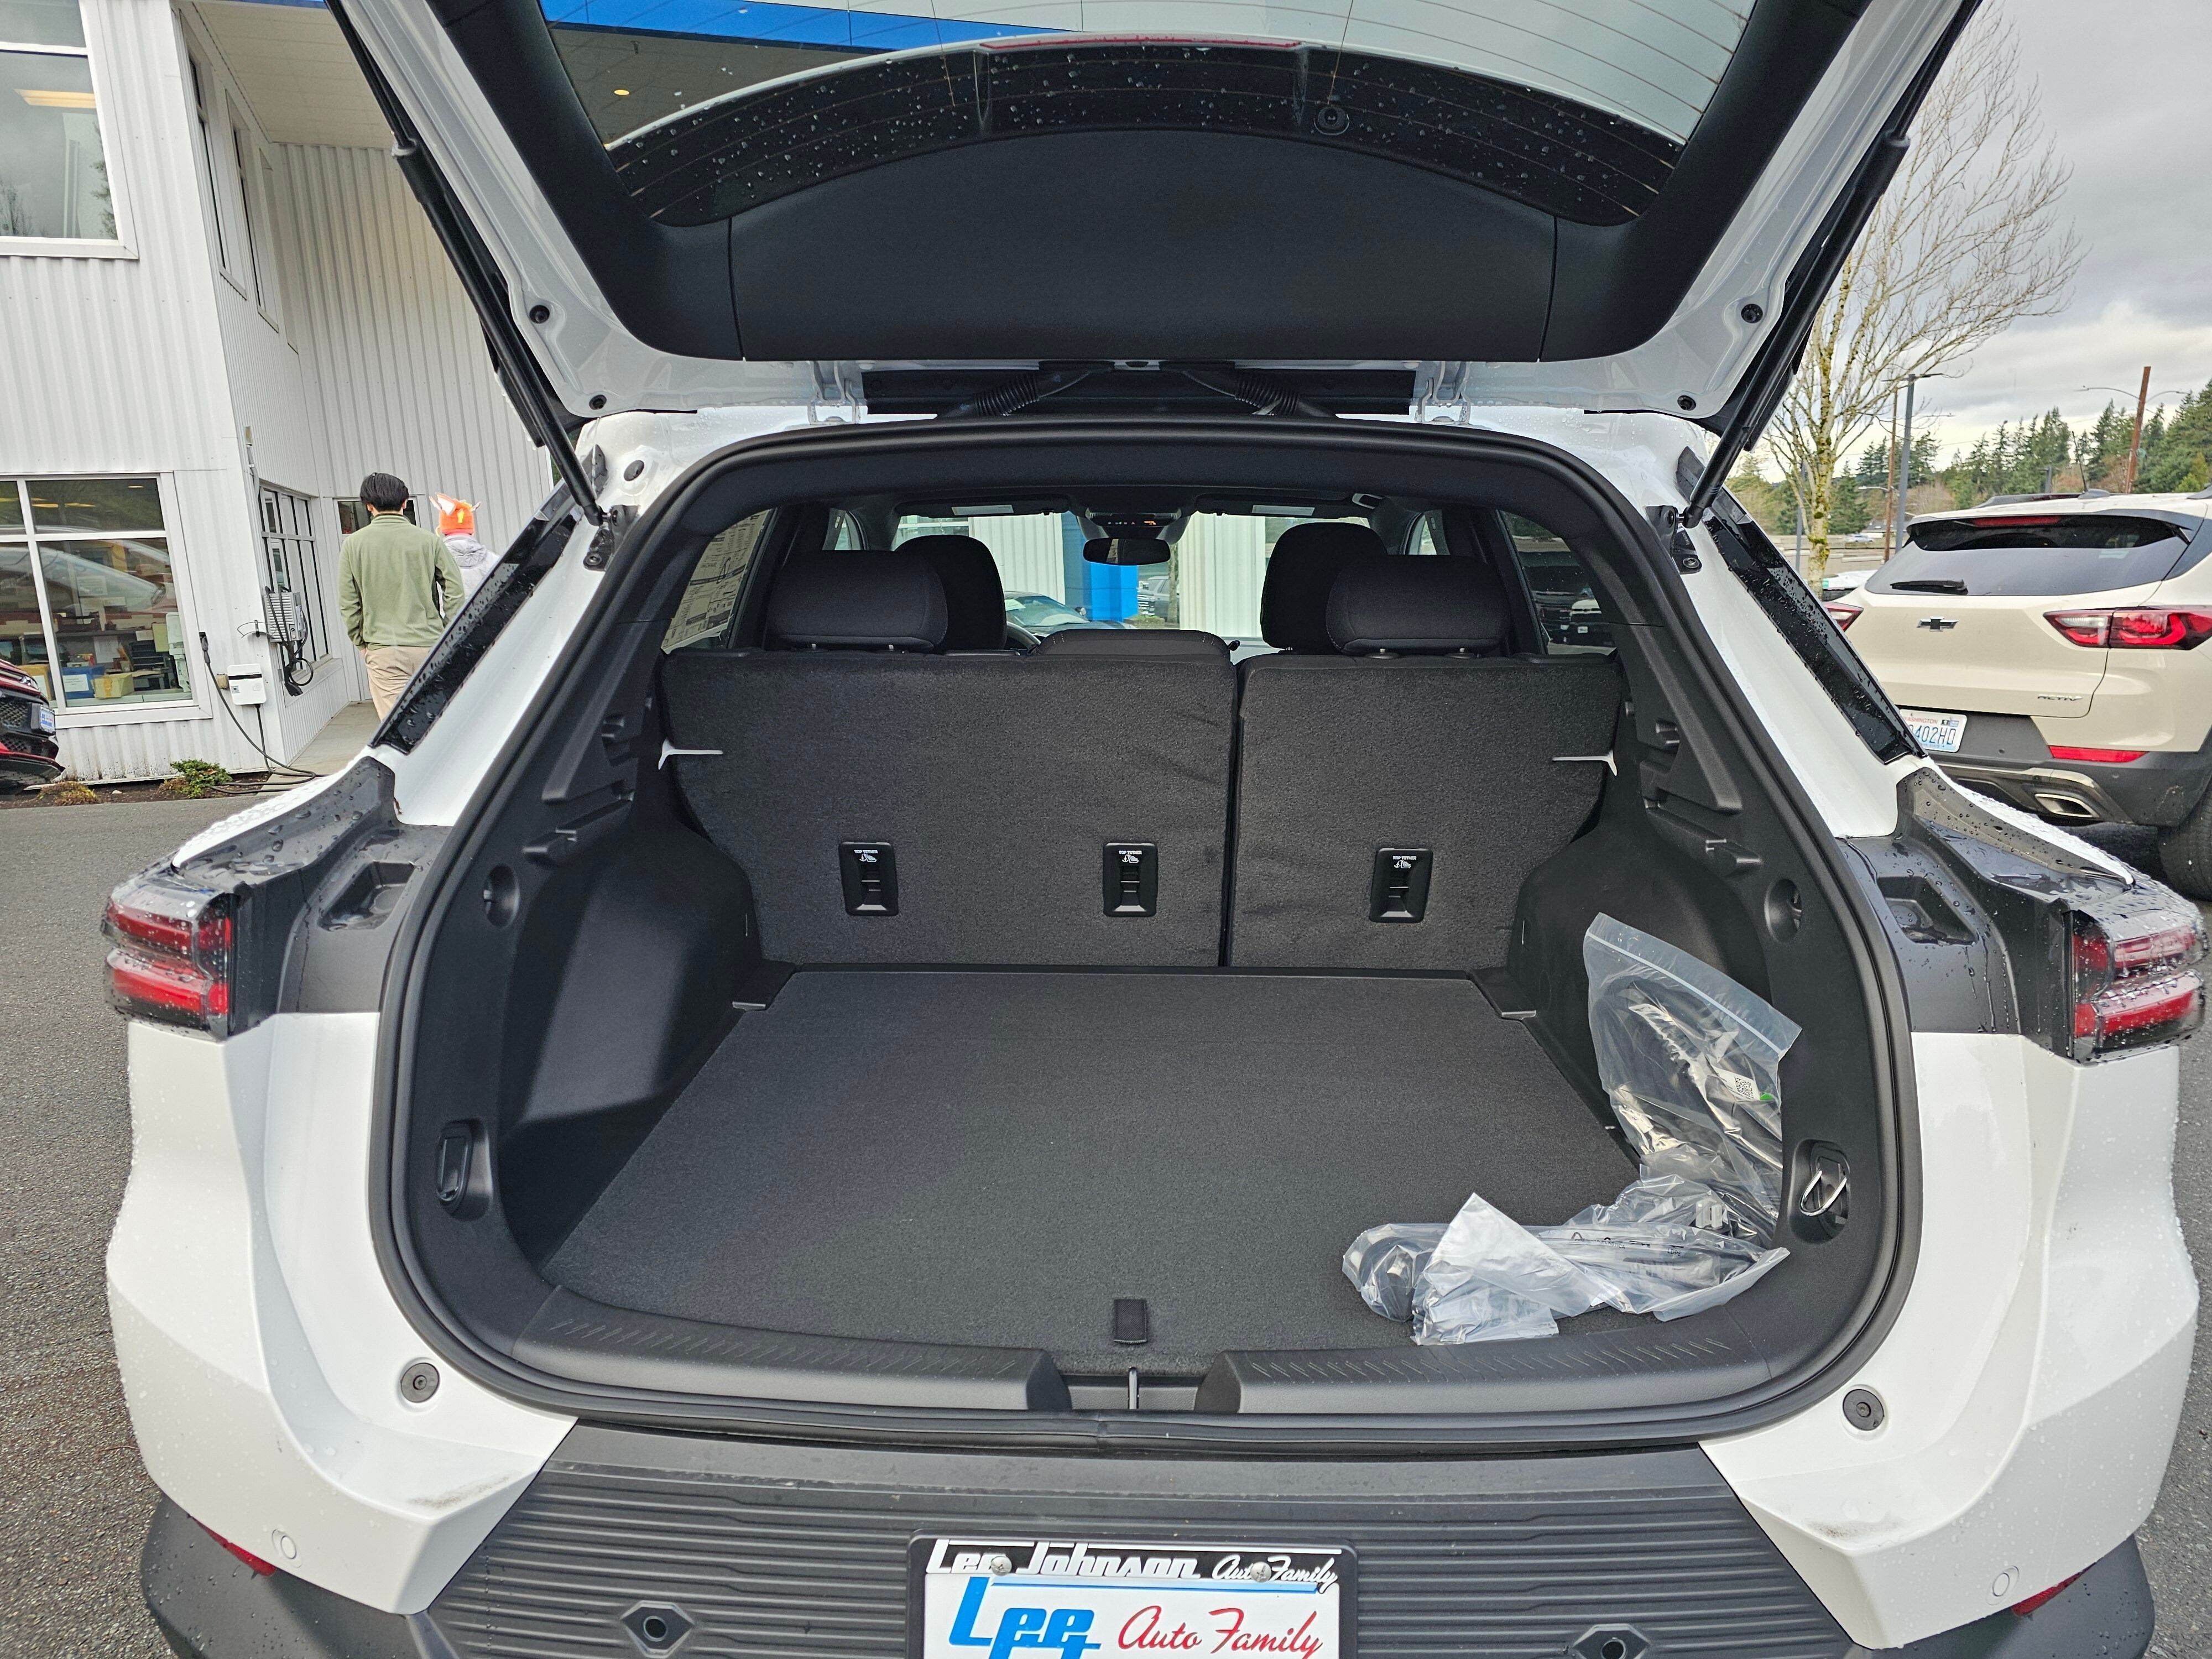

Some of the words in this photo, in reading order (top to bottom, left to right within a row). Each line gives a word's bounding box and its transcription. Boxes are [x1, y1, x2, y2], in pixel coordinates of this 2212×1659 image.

[1015, 1541, 1201, 1579] Johnson
[1267, 1555, 1338, 1594] Family
[949, 1576, 1098, 1649] Lee
[1118, 1605, 1202, 1650] Auto
[1208, 1607, 1323, 1659] Family
